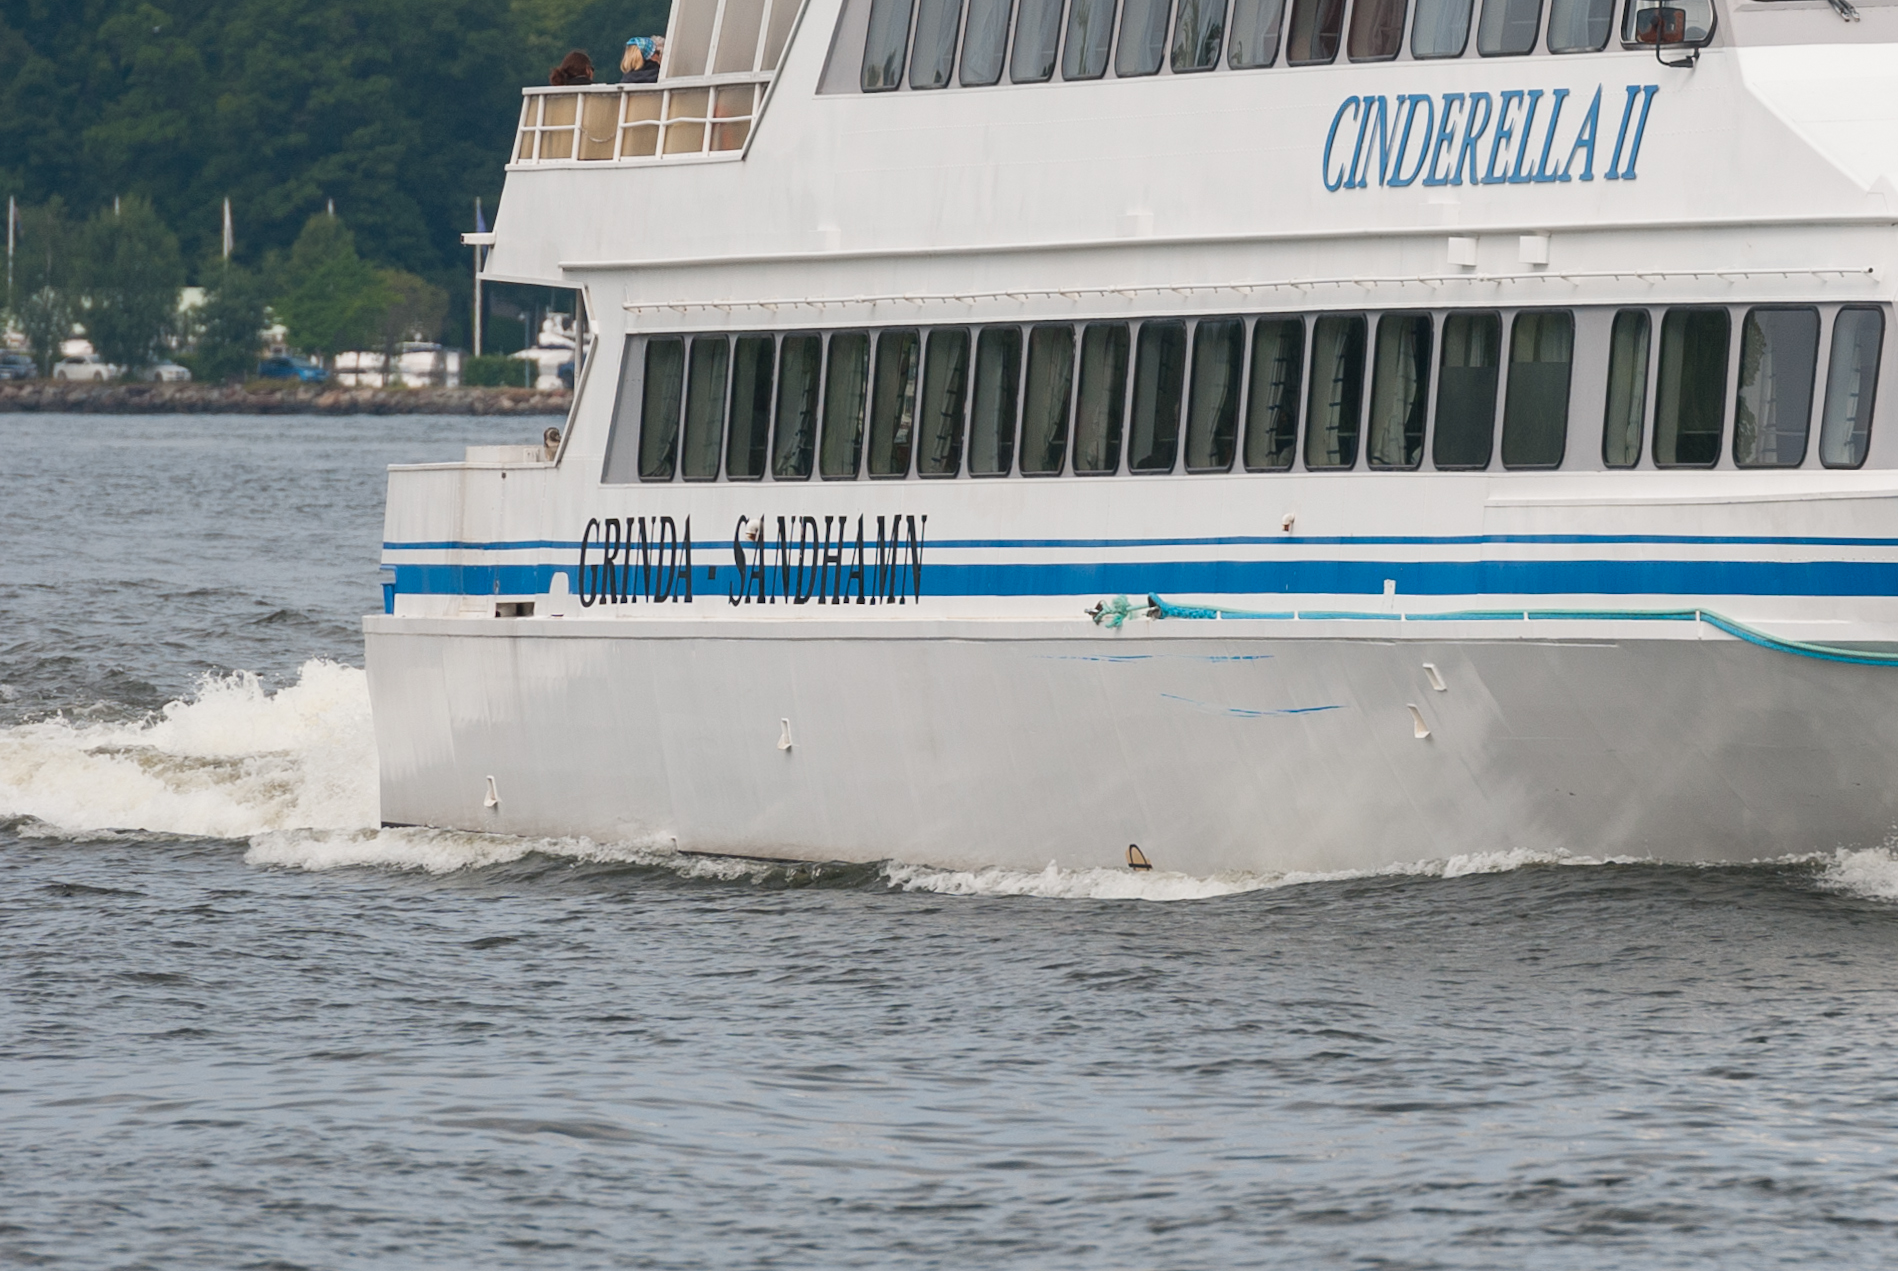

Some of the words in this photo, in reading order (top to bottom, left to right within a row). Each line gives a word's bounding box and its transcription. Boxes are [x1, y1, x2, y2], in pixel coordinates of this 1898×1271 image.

[1323, 83, 1602, 192] CINDERELLA
[1604, 84, 1659, 181] II
[579, 514, 693, 608] GRINDA
[728, 513, 928, 607] SANDHAMN
